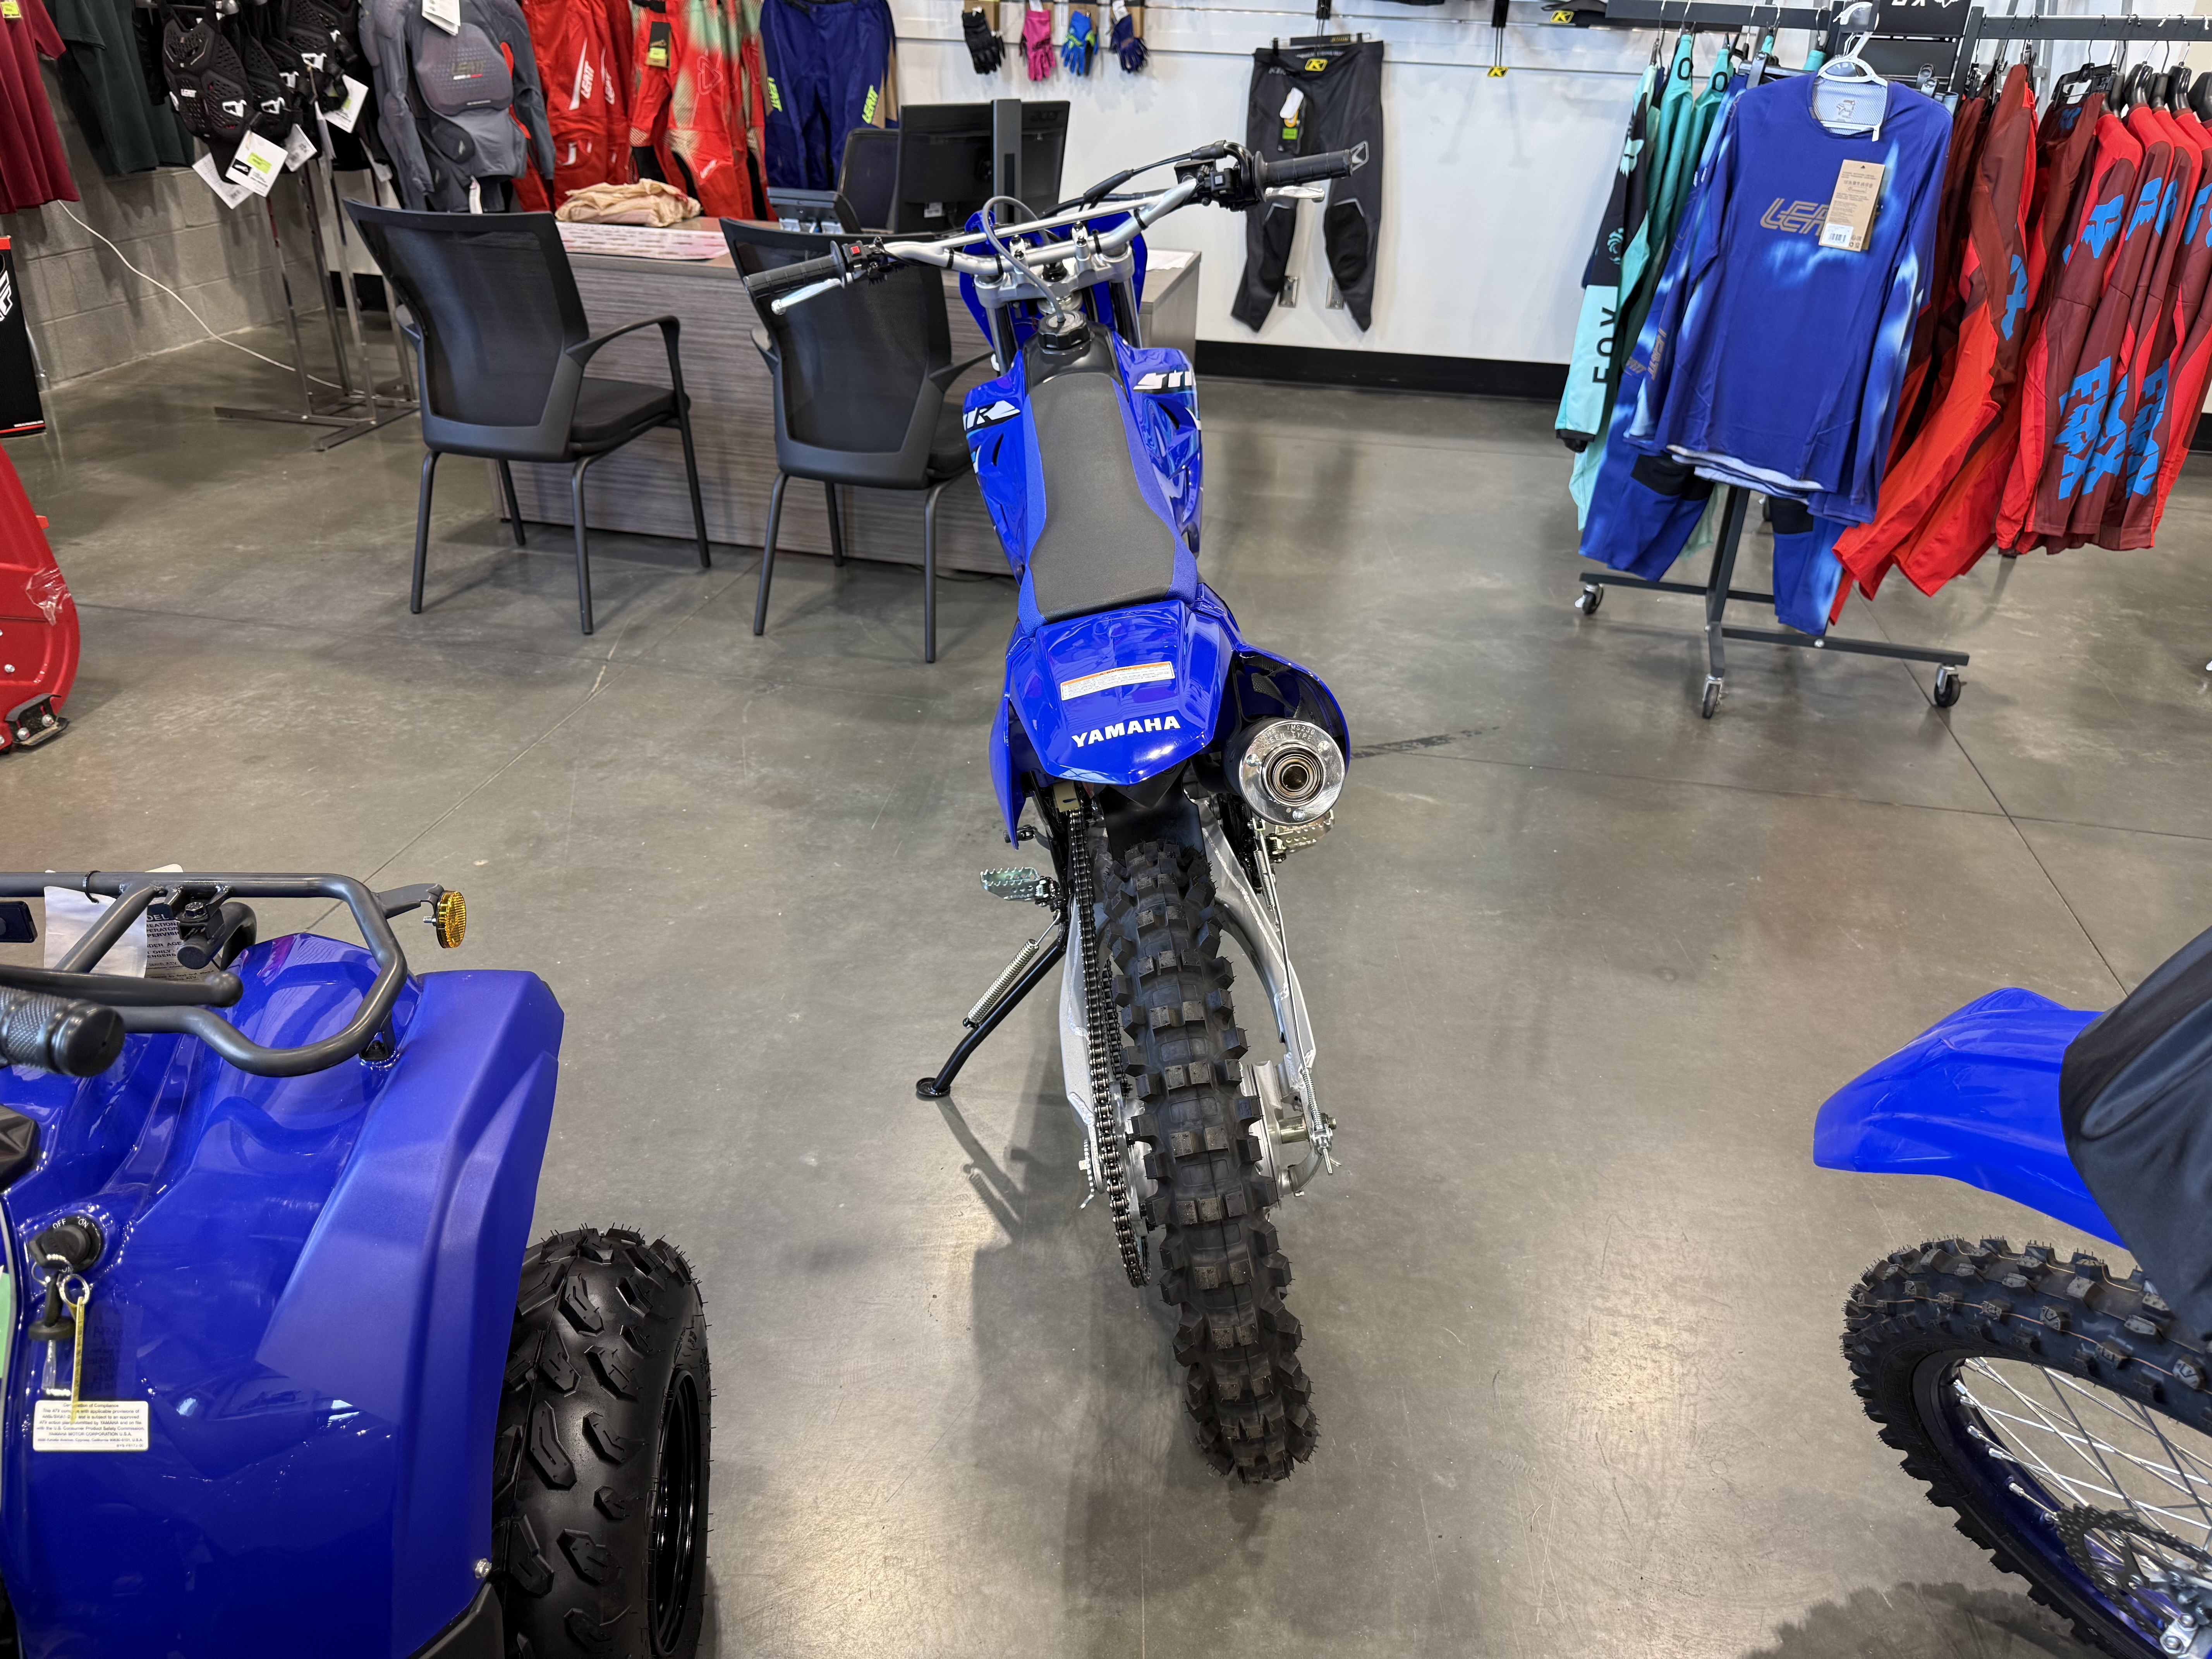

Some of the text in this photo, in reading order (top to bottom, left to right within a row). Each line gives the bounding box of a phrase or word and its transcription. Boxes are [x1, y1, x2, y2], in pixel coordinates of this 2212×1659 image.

[862, 84, 878, 124] LEATT
[1760, 198, 1830, 237] LEA
[1071, 716, 1181, 747] YAMAHA
[1291, 731, 1312, 742] TYPE
[53, 1218, 66, 1229] OFF
[78, 1218, 89, 1228] ON
